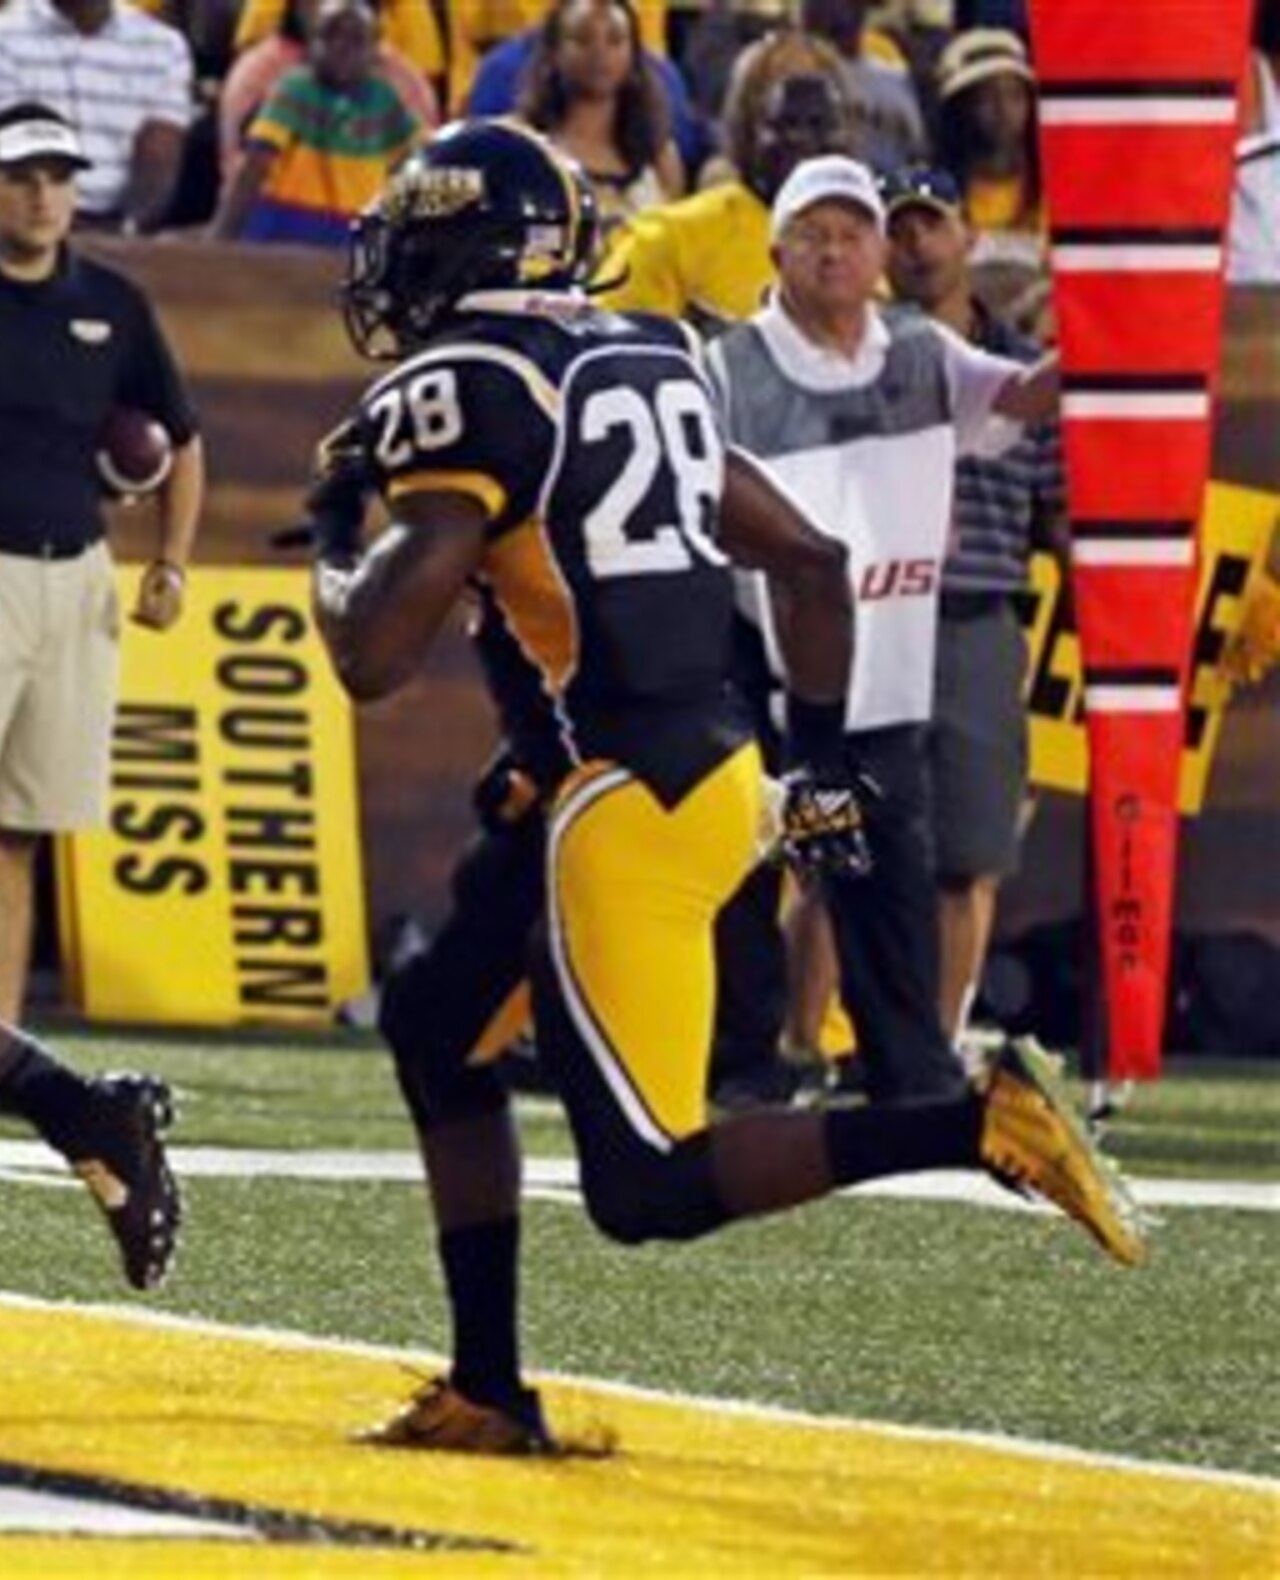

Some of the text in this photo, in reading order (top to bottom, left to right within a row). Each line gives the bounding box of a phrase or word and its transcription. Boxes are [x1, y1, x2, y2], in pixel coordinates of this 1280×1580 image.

[369, 368, 463, 467] 28
[581, 380, 730, 578] 28
[859, 558, 936, 601] US
[110, 703, 209, 896] MISS
[212, 601, 331, 1009] SOUTHERN
